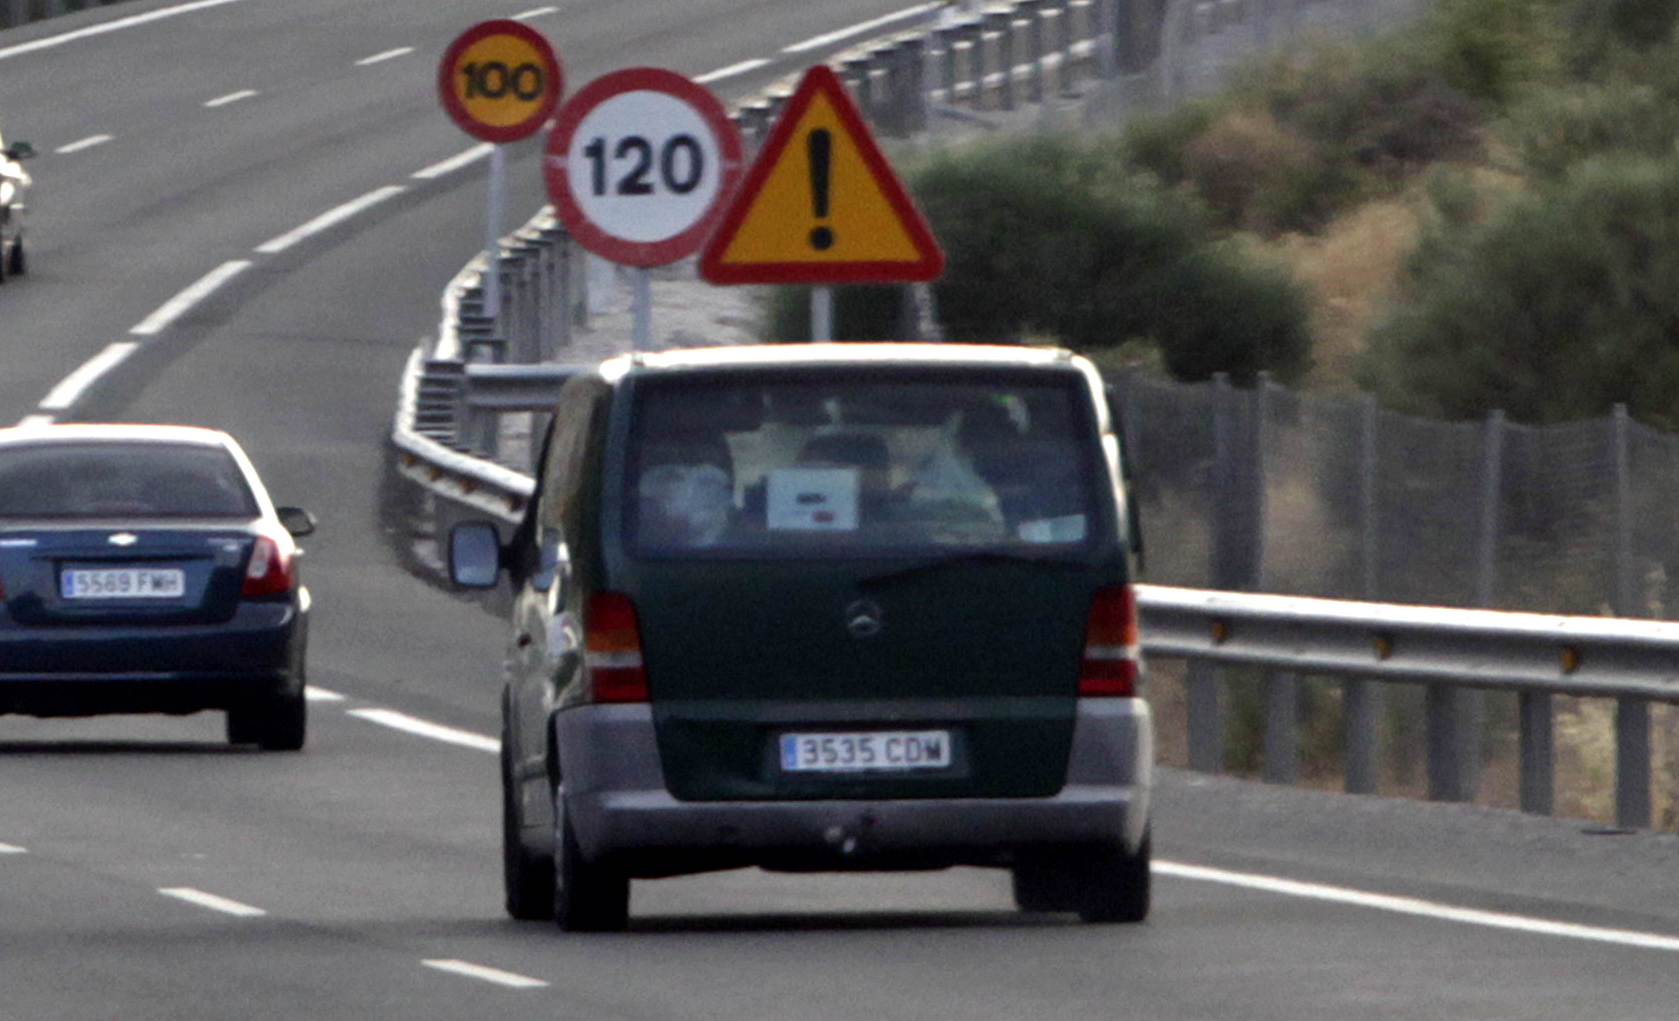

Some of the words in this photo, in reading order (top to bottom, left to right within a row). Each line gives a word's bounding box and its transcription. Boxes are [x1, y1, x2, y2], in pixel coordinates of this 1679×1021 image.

[462, 61, 544, 101] 100
[584, 134, 704, 196] 120
[803, 738, 875, 764] 3535
